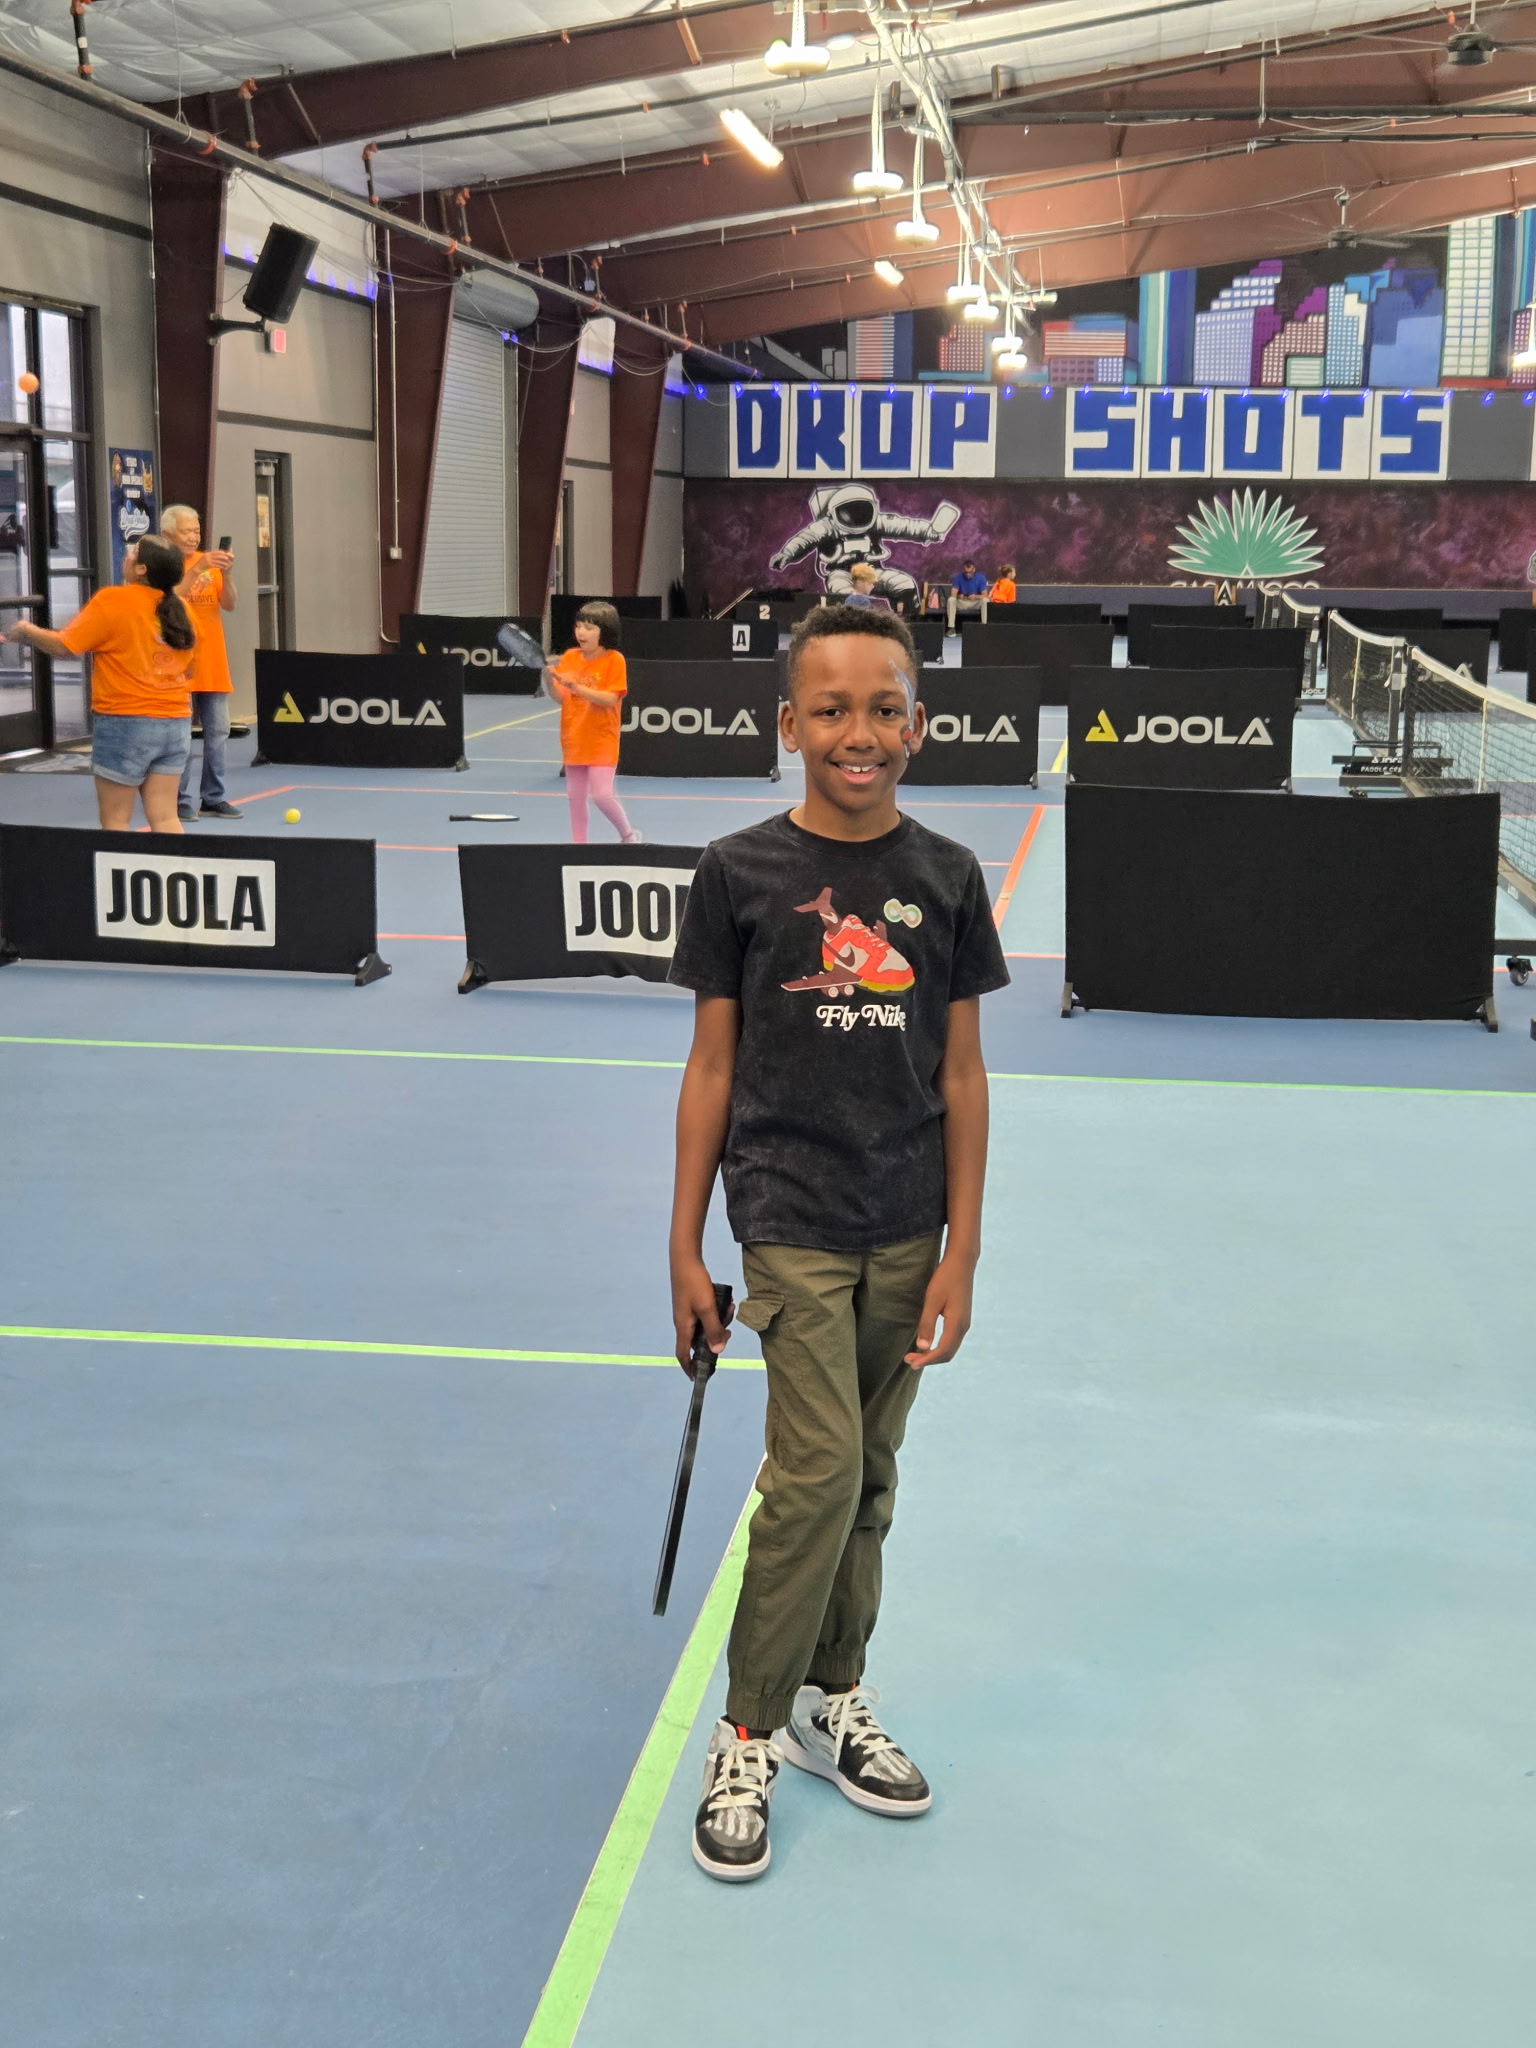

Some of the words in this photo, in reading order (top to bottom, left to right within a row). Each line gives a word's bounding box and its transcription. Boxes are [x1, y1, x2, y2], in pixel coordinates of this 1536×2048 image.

[736, 388, 991, 470] DROP
[1072, 390, 1446, 473] SHOTS
[759, 604, 771, 620] 2
[309, 698, 447, 726] JOOLA
[621, 706, 760, 736] JOOLA
[922, 714, 1021, 743] OLA
[1123, 715, 1274, 746] JOOLA
[106, 868, 267, 932] JOOLA
[575, 880, 691, 943] JOO
[816, 1005, 860, 1031] Fly
